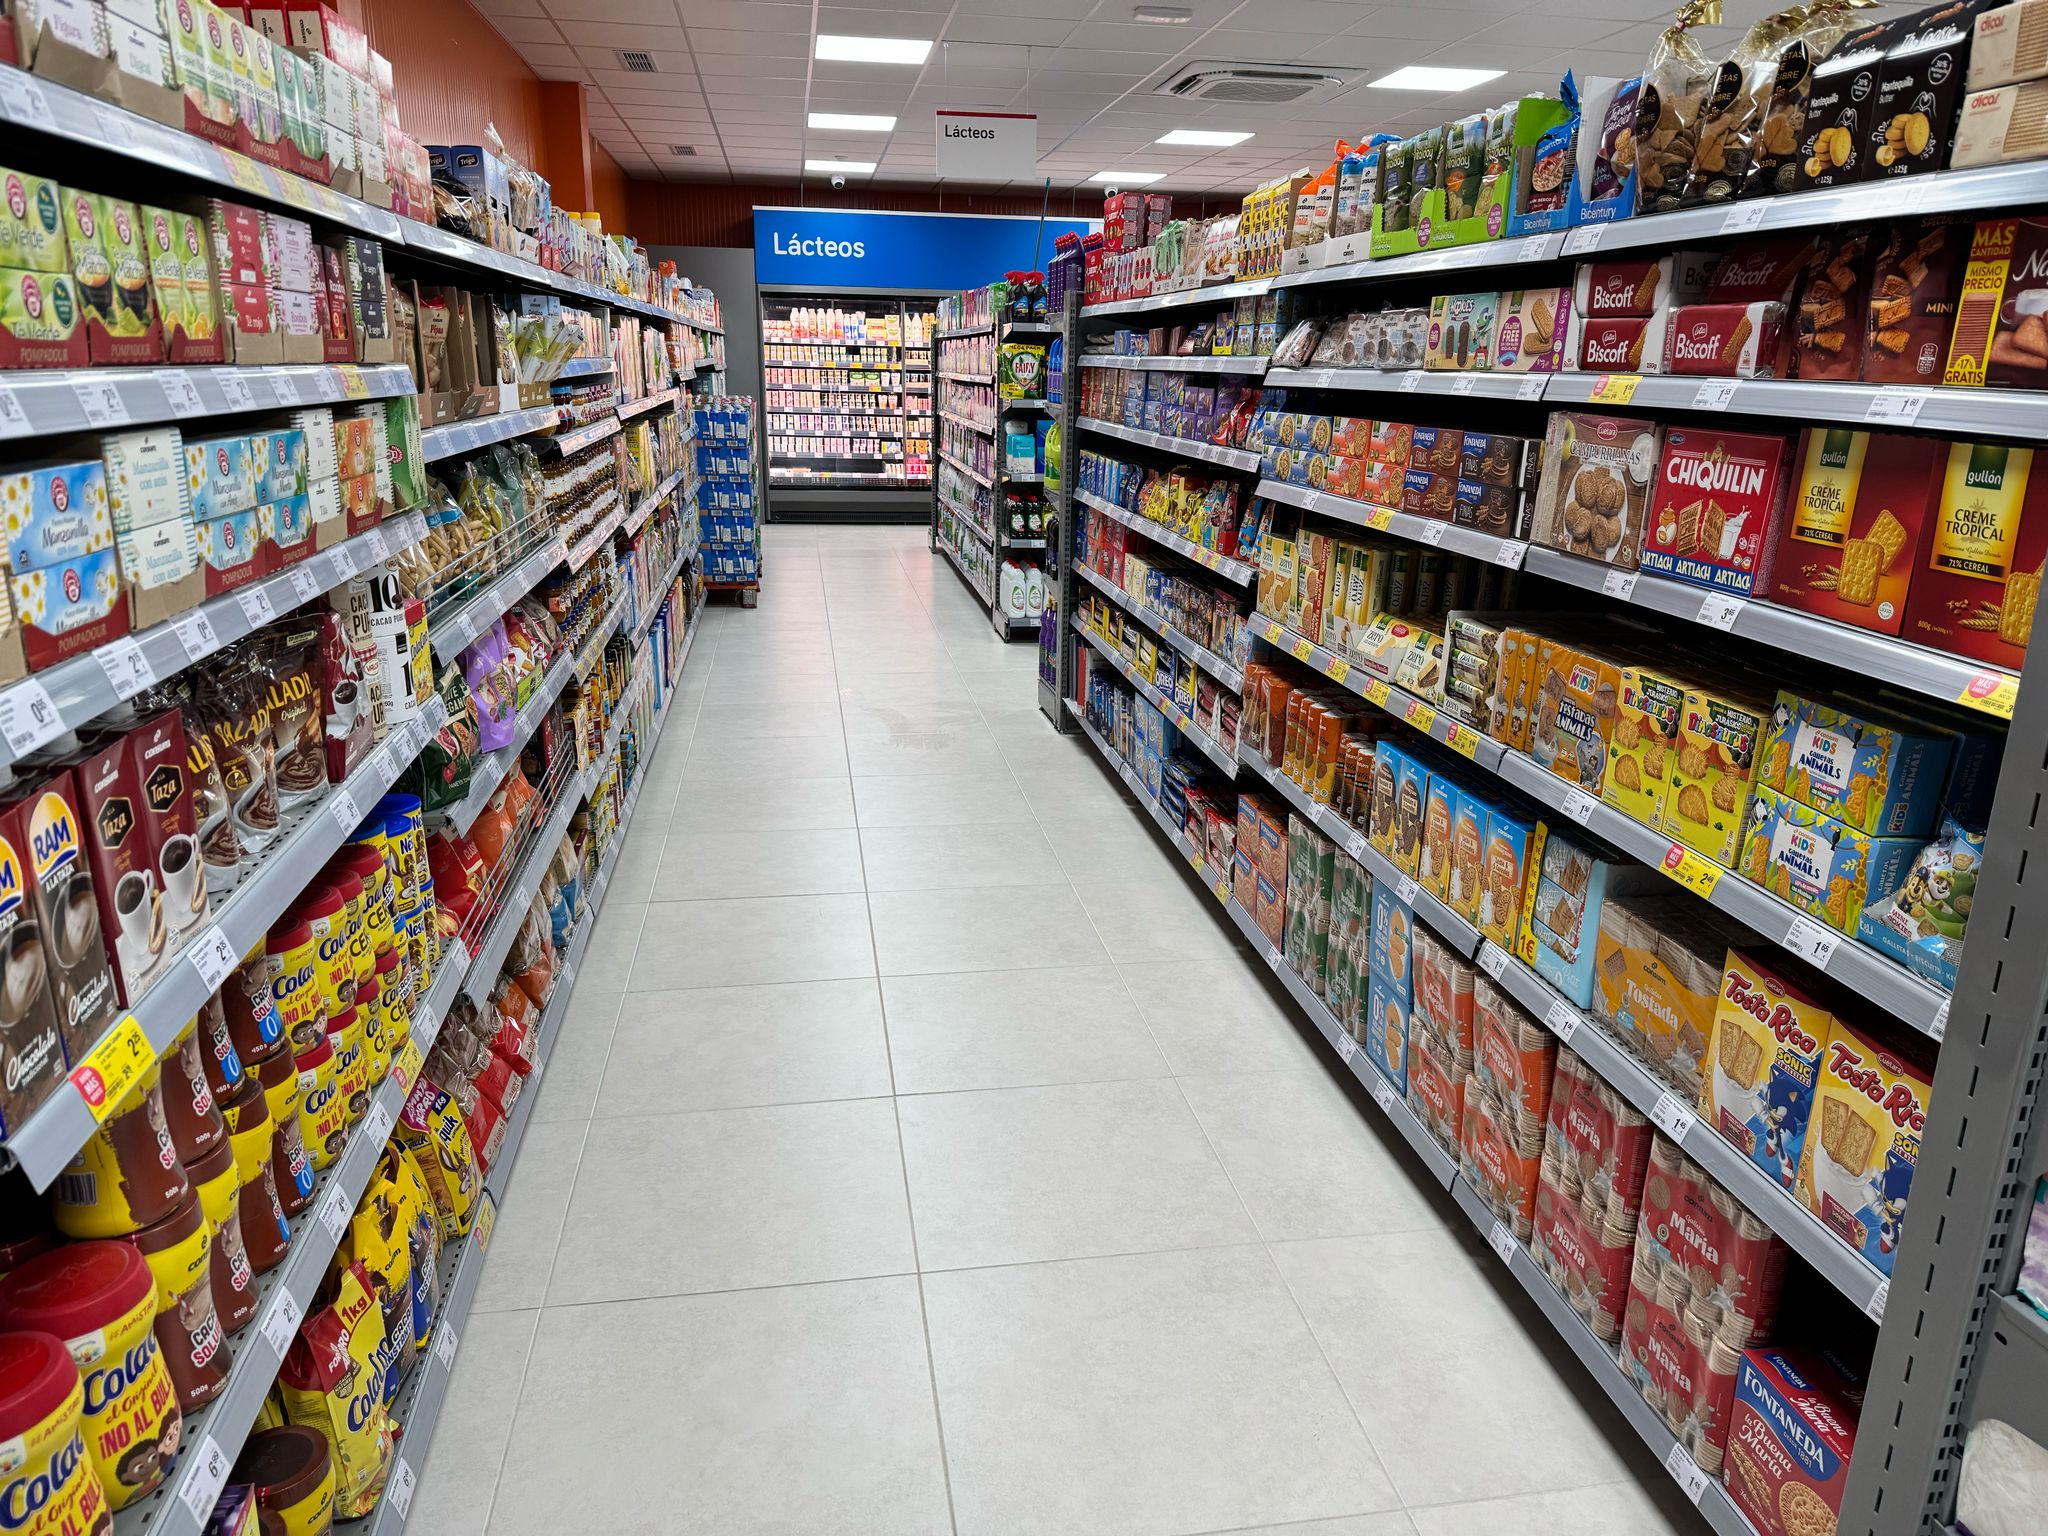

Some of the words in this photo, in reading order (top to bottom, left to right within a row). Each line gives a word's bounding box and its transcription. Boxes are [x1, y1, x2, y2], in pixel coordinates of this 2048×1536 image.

[1881, 76, 1914, 93] Mantequilla
[1810, 93, 1839, 109] Mantequilla
[1878, 93, 1895, 104] Butter
[1808, 108, 1822, 119] Butter
[944, 124, 995, 139] Lácteos
[457, 153, 479, 166] Trigo
[1524, 217, 1552, 230] Bicentury
[1581, 207, 1617, 220] Bicentury
[13, 227, 44, 249] Verde
[773, 231, 865, 258] Lácteos
[1973, 224, 2016, 246] MÁS
[1971, 246, 2011, 256] CANTIDAD
[1720, 262, 1777, 287] Biscoff
[1970, 265, 2002, 277] MISMO
[1964, 277, 2003, 290] PRECIO
[1593, 284, 1634, 309] Biscoff
[1926, 302, 1953, 313] MINI
[1502, 330, 1519, 342] FREE
[20, 348, 68, 361] POMPADOUR
[111, 344, 151, 356] POMPADOUR
[184, 345, 214, 358] POMPADOUR
[1587, 340, 1629, 364] Biscoff
[1675, 334, 1720, 360] Biscoff
[1015, 360, 1036, 374] FAIRY
[1945, 370, 1983, 383] GRATIS
[1414, 430, 1434, 442] FONTANEDA
[1464, 435, 1486, 449] FONTANEDA
[1415, 450, 1427, 464] FINAS
[1569, 440, 1641, 465] CAMPURRIANAS
[1821, 452, 1847, 466] gullón
[271, 464, 295, 481] Manzanilla
[1465, 458, 1478, 472] FINAS
[1526, 452, 1535, 478] FINAS
[213, 477, 242, 496] Manzanilla
[1405, 472, 1429, 485] FONTANEDA
[1666, 457, 1765, 496] CHIQUILIN
[1968, 470, 2002, 486] gullón
[1457, 481, 1482, 496] FONTANEDA
[1810, 485, 1841, 499] CREME
[1407, 493, 1421, 507] FINAS
[1803, 496, 1846, 513] TROPICAL
[1459, 504, 1473, 519] FINAS
[1523, 503, 1532, 529] FINAS
[1954, 509, 1997, 527] CREME
[42, 518, 89, 548] Manzanilla
[1803, 528, 1814, 538] 71%
[1814, 530, 1834, 541] CEREAL
[1945, 521, 2005, 542] TROPICAL
[282, 546, 308, 562] POMPADOUR
[1280, 558, 1292, 570] zero
[1641, 550, 1673, 572] ARTIACH
[1675, 558, 1711, 581] ARTIACH
[1948, 559, 1962, 569] 71%
[1963, 562, 1990, 574] CEREAL
[222, 570, 253, 585] POMPADOUR
[370, 617, 392, 627] CACAO
[58, 624, 108, 653] POMPADOUR
[1366, 630, 1383, 643] zero
[1407, 650, 1424, 665] zero
[1570, 672, 1596, 694] KIDS
[281, 701, 307, 722] Original
[1555, 713, 1593, 742] ANIMALS
[144, 739, 171, 759] consum
[1812, 736, 1838, 756] KIDS
[1798, 754, 1842, 780] ANIMALS
[1903, 743, 1924, 800] ANIMALS
[95, 770, 119, 793] consum
[150, 778, 177, 804] Taza
[103, 812, 127, 841] Taza
[1892, 802, 1909, 832] KIDS
[33, 816, 71, 866] RAM
[1497, 828, 1513, 840] consum
[1791, 834, 1816, 855] KIDS
[1778, 852, 1820, 880] ANIMALS
[1891, 909, 1908, 926] MINI
[1519, 934, 1536, 961] 1€
[1915, 953, 1941, 974] BISCUITS
[1643, 965, 1667, 985] consum
[68, 970, 109, 1027] Chocolate
[300, 1002, 312, 1016] AL
[1626, 979, 1679, 1030] Tostada
[1725, 971, 1770, 1021] Tosta
[1768, 1004, 1816, 1055] Rica
[6, 1026, 56, 1091] Chocolate
[1485, 1040, 1513, 1079] Dorada
[1776, 1048, 1811, 1078] SONIC
[354, 1073, 363, 1089] AL
[1416, 1075, 1443, 1108] Dorada
[1828, 1042, 1885, 1104] Tosta
[1883, 1084, 1925, 1132] Ric
[434, 1094, 448, 1114] 1kg
[331, 1115, 341, 1131] AL
[1568, 1108, 1601, 1150] María
[1482, 1140, 1502, 1166] María
[1684, 1194, 1713, 1224] consum
[1669, 1209, 1719, 1265] María
[1554, 1227, 1586, 1269] María
[341, 1296, 367, 1325] 1kg
[1658, 1321, 1687, 1352] consum
[1648, 1335, 1692, 1392] María
[1773, 1356, 1807, 1389] FONTANEDA
[106, 1405, 121, 1425] el
[122, 1360, 158, 1411] Original
[1744, 1365, 1825, 1473] FONTANEDA
[1790, 1397, 1831, 1433] María
[1815, 1404, 1849, 1436] Buena
[98, 1421, 131, 1461] ¡NO
[133, 1412, 153, 1436] AL
[1744, 1413, 1754, 1427] la
[1753, 1419, 1792, 1473] Buena
[1740, 1424, 1783, 1480] María
[1783, 1432, 1798, 1449] DESDE
[1797, 1448, 1813, 1468] 1881
[47, 1462, 86, 1522] Original
